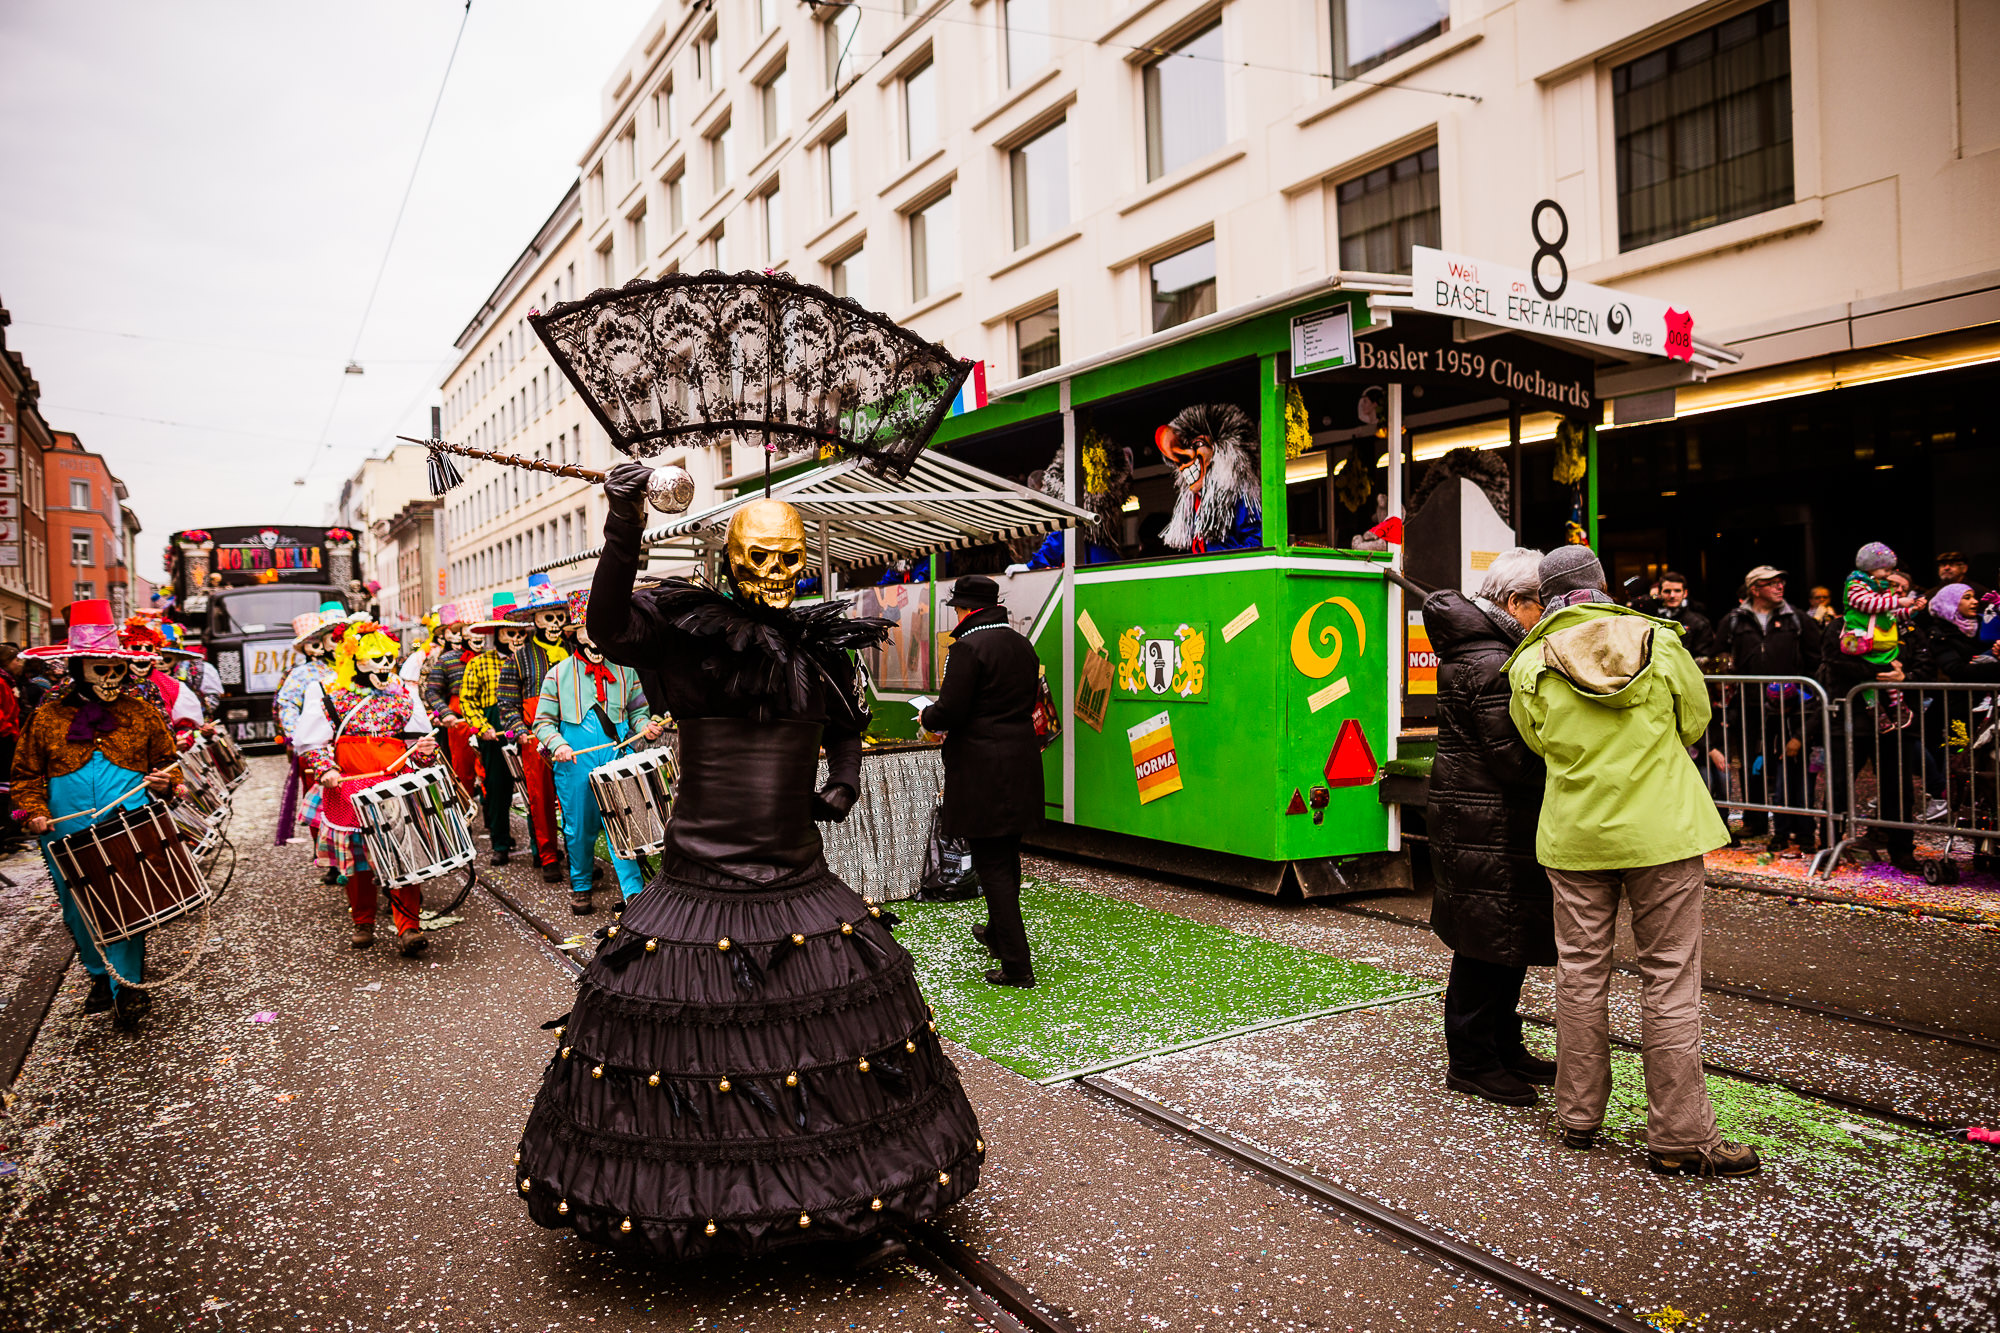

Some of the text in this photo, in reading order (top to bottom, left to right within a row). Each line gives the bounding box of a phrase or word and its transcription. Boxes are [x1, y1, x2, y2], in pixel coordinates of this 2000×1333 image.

[1531, 199, 1568, 301] 8
[1448, 261, 1527, 294] Weil an
[1436, 281, 1599, 336] BASEL ERFAHREN
[1632, 331, 1652, 347] BVB
[1668, 330, 1689, 347] 008
[1357, 341, 1428, 371] Basler
[1435, 348, 1485, 378] 1959
[1490, 359, 1590, 409] Clochards
[59, 457, 98, 473] HOTEL
[216, 547, 322, 570] MORTA BELLA
[1409, 652, 1440, 667] NOR
[1136, 751, 1175, 780] NORMA
